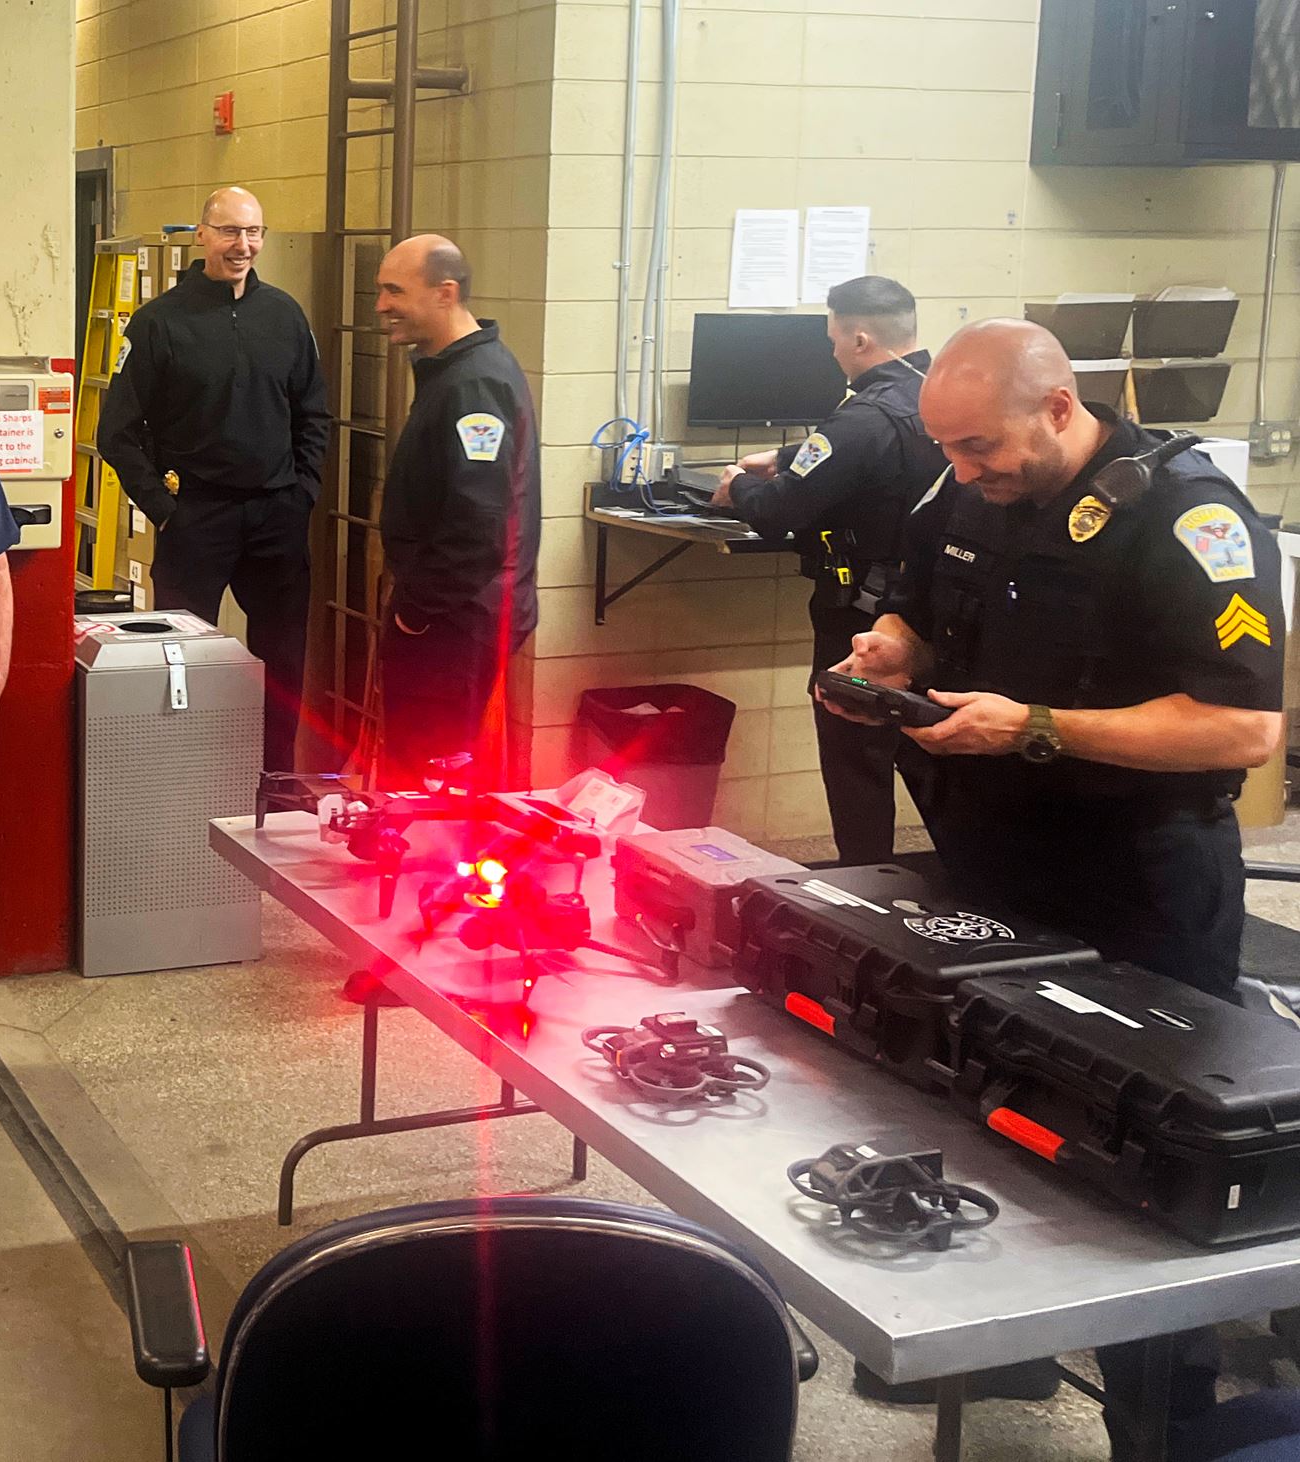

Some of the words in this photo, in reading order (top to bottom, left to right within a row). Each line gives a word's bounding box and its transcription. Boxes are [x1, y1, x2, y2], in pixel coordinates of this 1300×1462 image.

[3, 414, 32, 423] Sharps
[27, 428, 34, 436] is
[5, 443, 15, 451] to
[17, 442, 32, 450] the
[5, 456, 40, 464] cabinet.
[944, 544, 976, 563] MILLER
